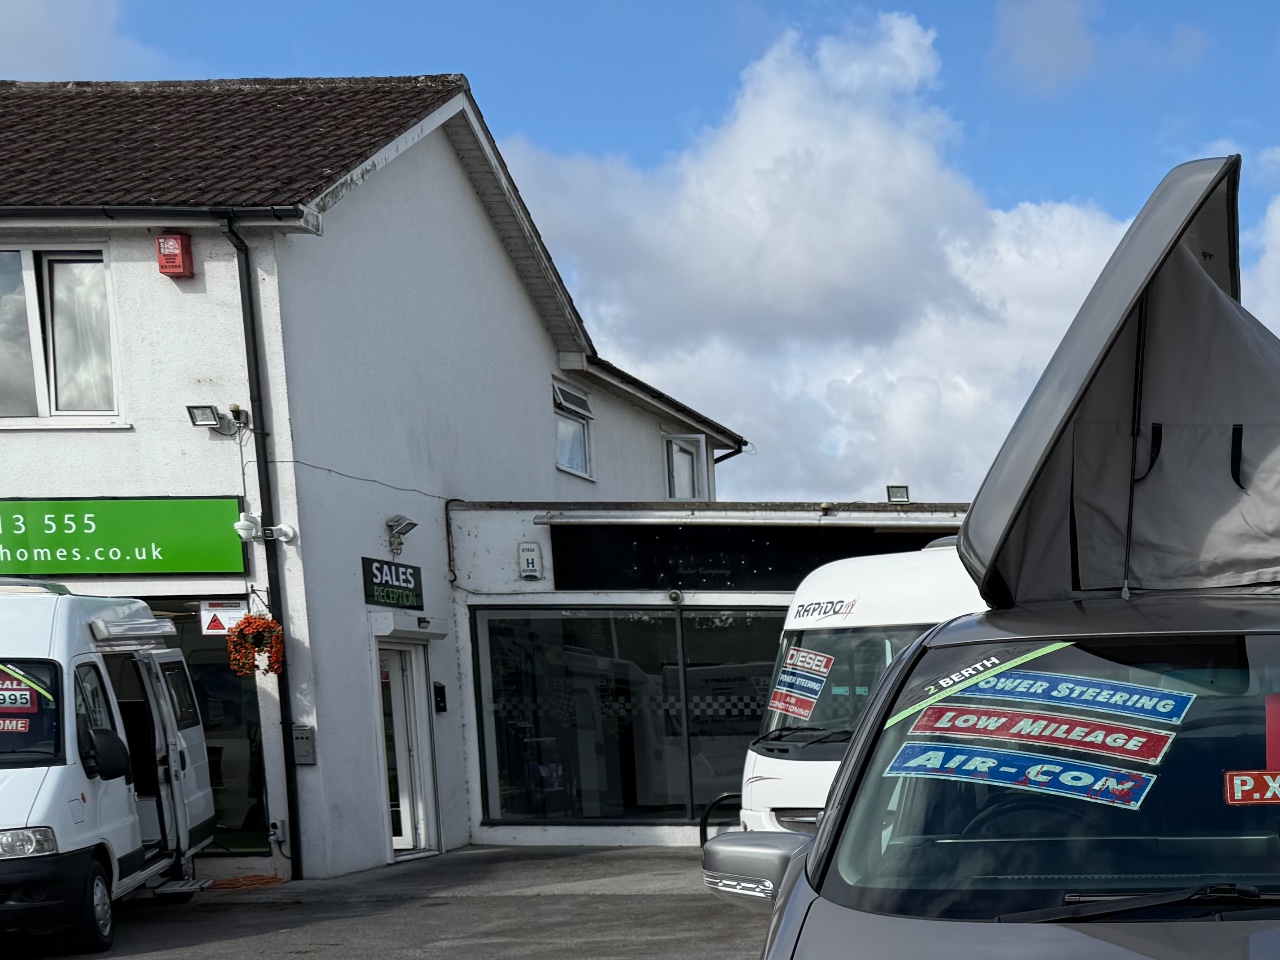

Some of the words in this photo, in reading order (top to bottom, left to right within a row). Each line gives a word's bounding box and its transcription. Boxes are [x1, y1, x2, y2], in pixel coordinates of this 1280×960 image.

[44, 514, 97, 534] 555
[0, 543, 164, 562] homes.co.uk
[372, 561, 415, 589] SALES
[373, 585, 417, 606] RECEPTION
[786, 649, 828, 673] DIESEL
[780, 674, 797, 684] POWER
[796, 677, 821, 691] STEERING
[924, 685, 939, 695] 2
[938, 656, 1000, 688] BERTH
[785, 696, 796, 704] AIR
[978, 676, 1050, 694] OWER
[1050, 682, 1176, 714] STEERING
[770, 700, 810, 717] CONDITIONING
[933, 711, 1008, 731] LOW
[1011, 717, 1148, 751] MILEAGE
[902, 751, 1136, 793] AIR-CON
